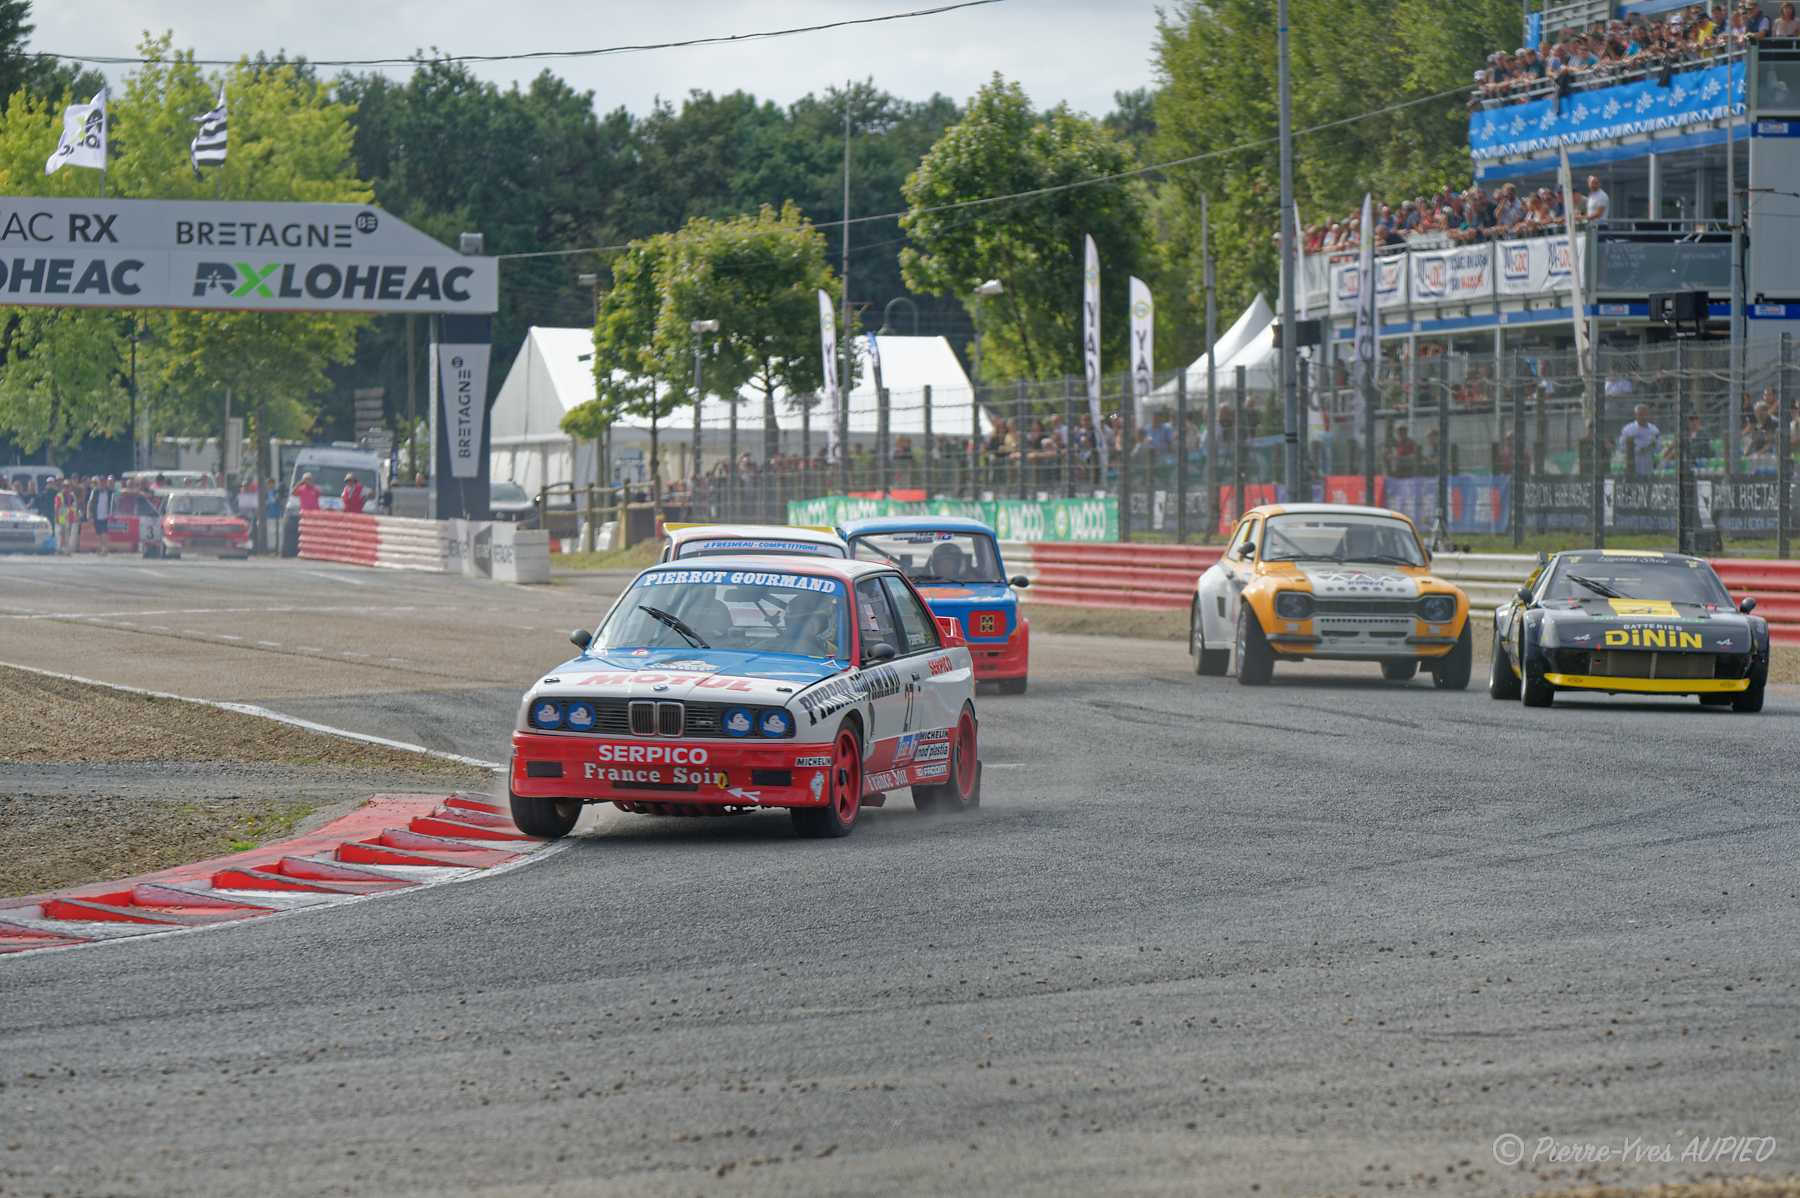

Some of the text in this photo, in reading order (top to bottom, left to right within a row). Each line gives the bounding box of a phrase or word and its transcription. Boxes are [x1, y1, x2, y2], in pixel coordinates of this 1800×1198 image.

[68, 213, 119, 243] RX
[176, 221, 353, 248] BRETAGNE
[0, 257, 145, 296] HEAC
[458, 368, 472, 459] BRETAGNE
[643, 571, 836, 594] PIERROT GOURMAND
[577, 673, 753, 692] MOTUL
[598, 744, 709, 765] SERPICO
[796, 757, 832, 767] MICHELIN
[584, 762, 660, 784] France
